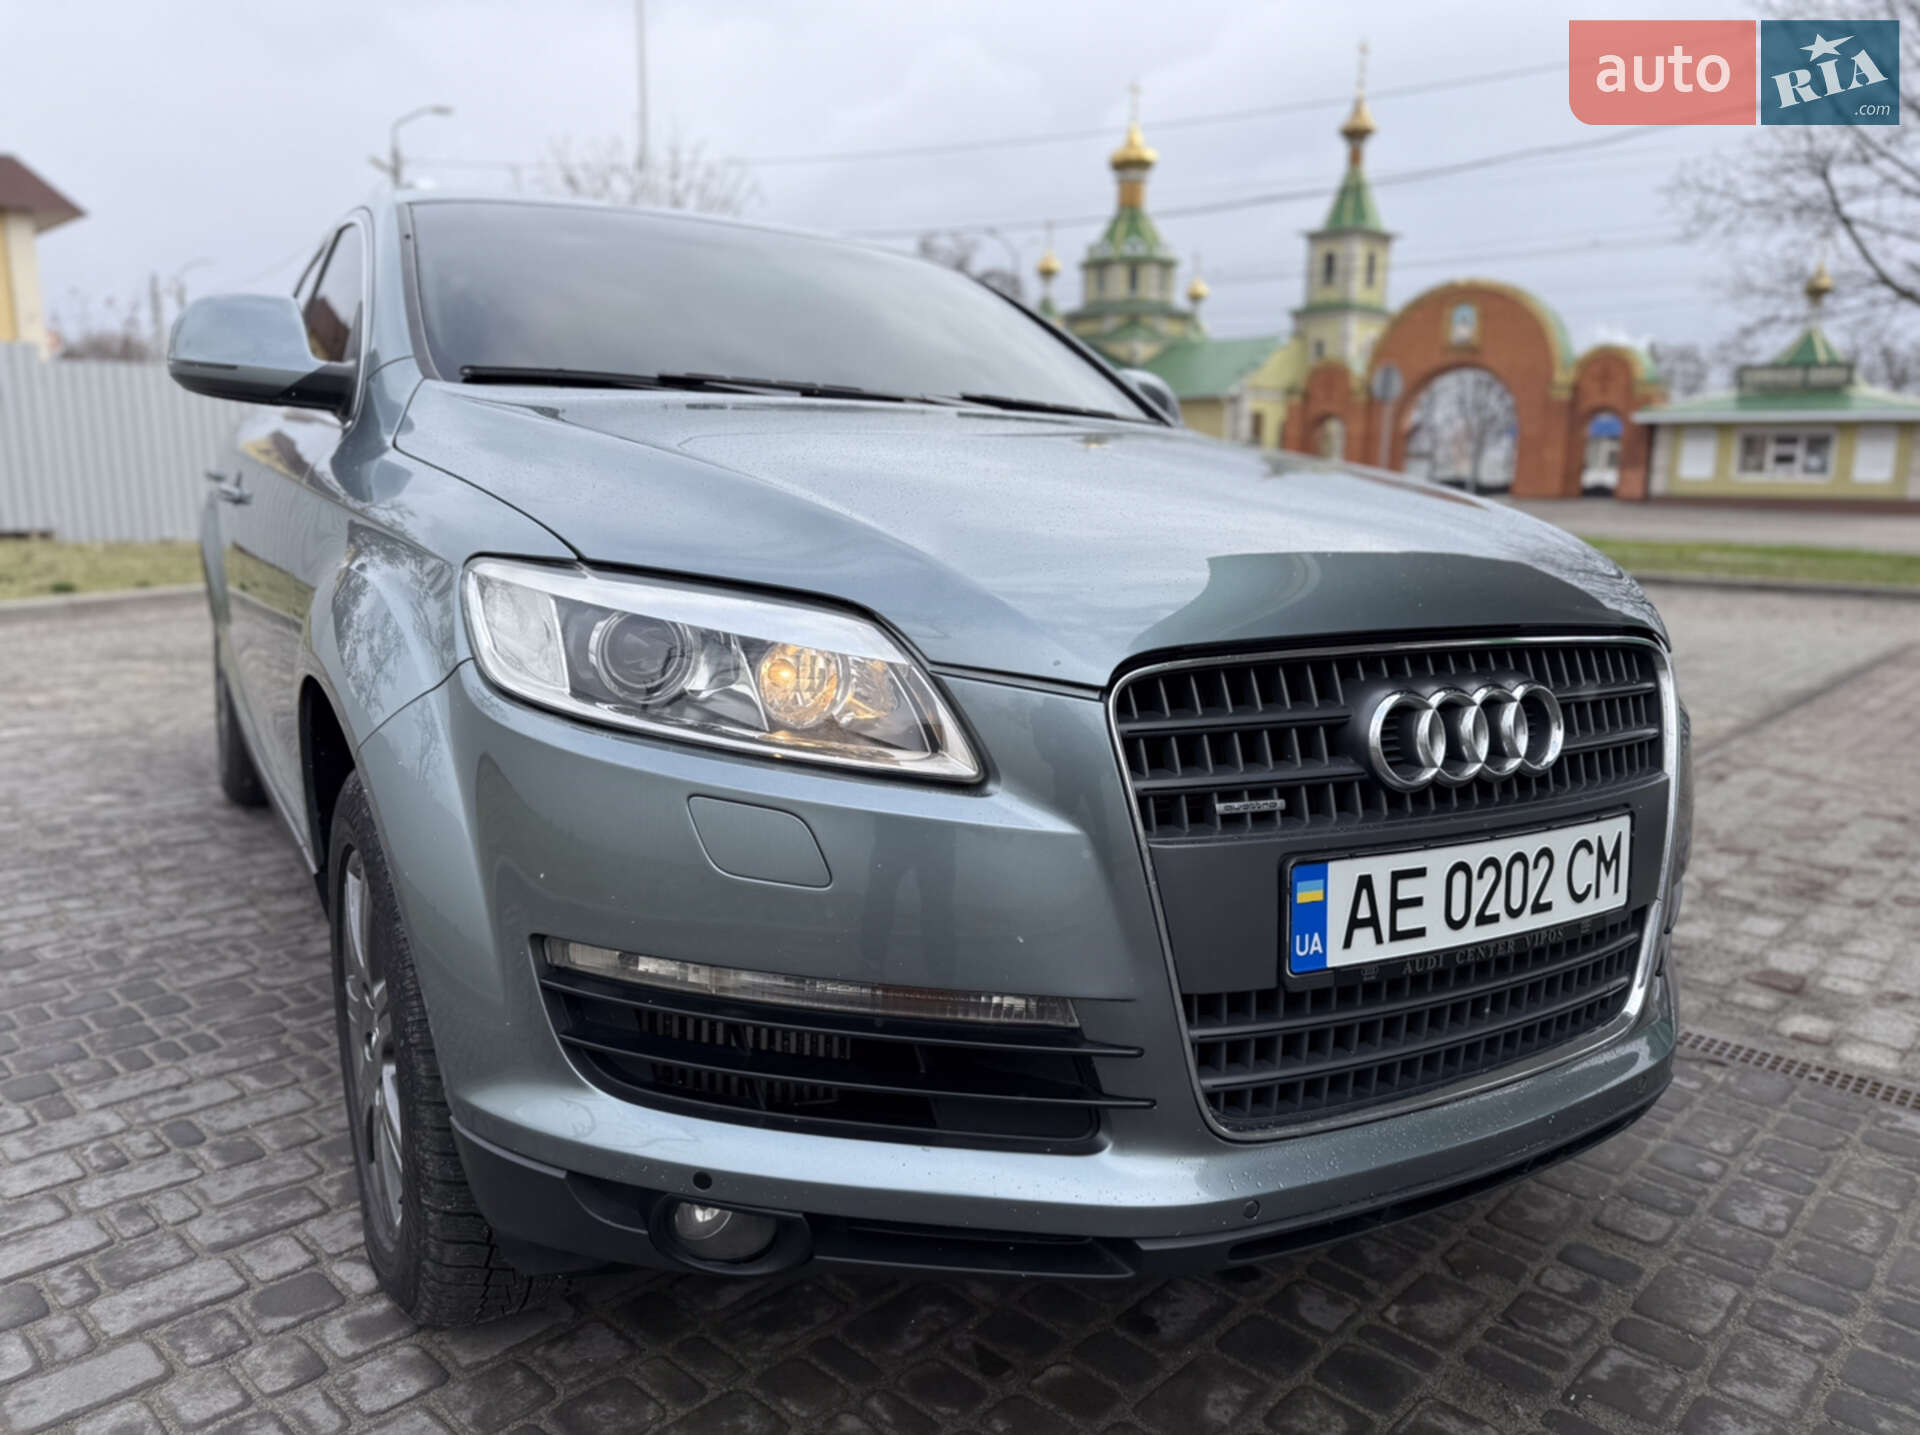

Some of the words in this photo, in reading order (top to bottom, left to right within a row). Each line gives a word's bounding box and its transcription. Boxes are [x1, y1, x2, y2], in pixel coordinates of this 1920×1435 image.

[1342, 866, 1428, 950] AE
[1444, 846, 1555, 931] 0202
[1567, 830, 1623, 904] CM
[1295, 933, 1323, 956] UA
[1402, 954, 1443, 975] AUDI
[1456, 939, 1515, 965] CENTER
